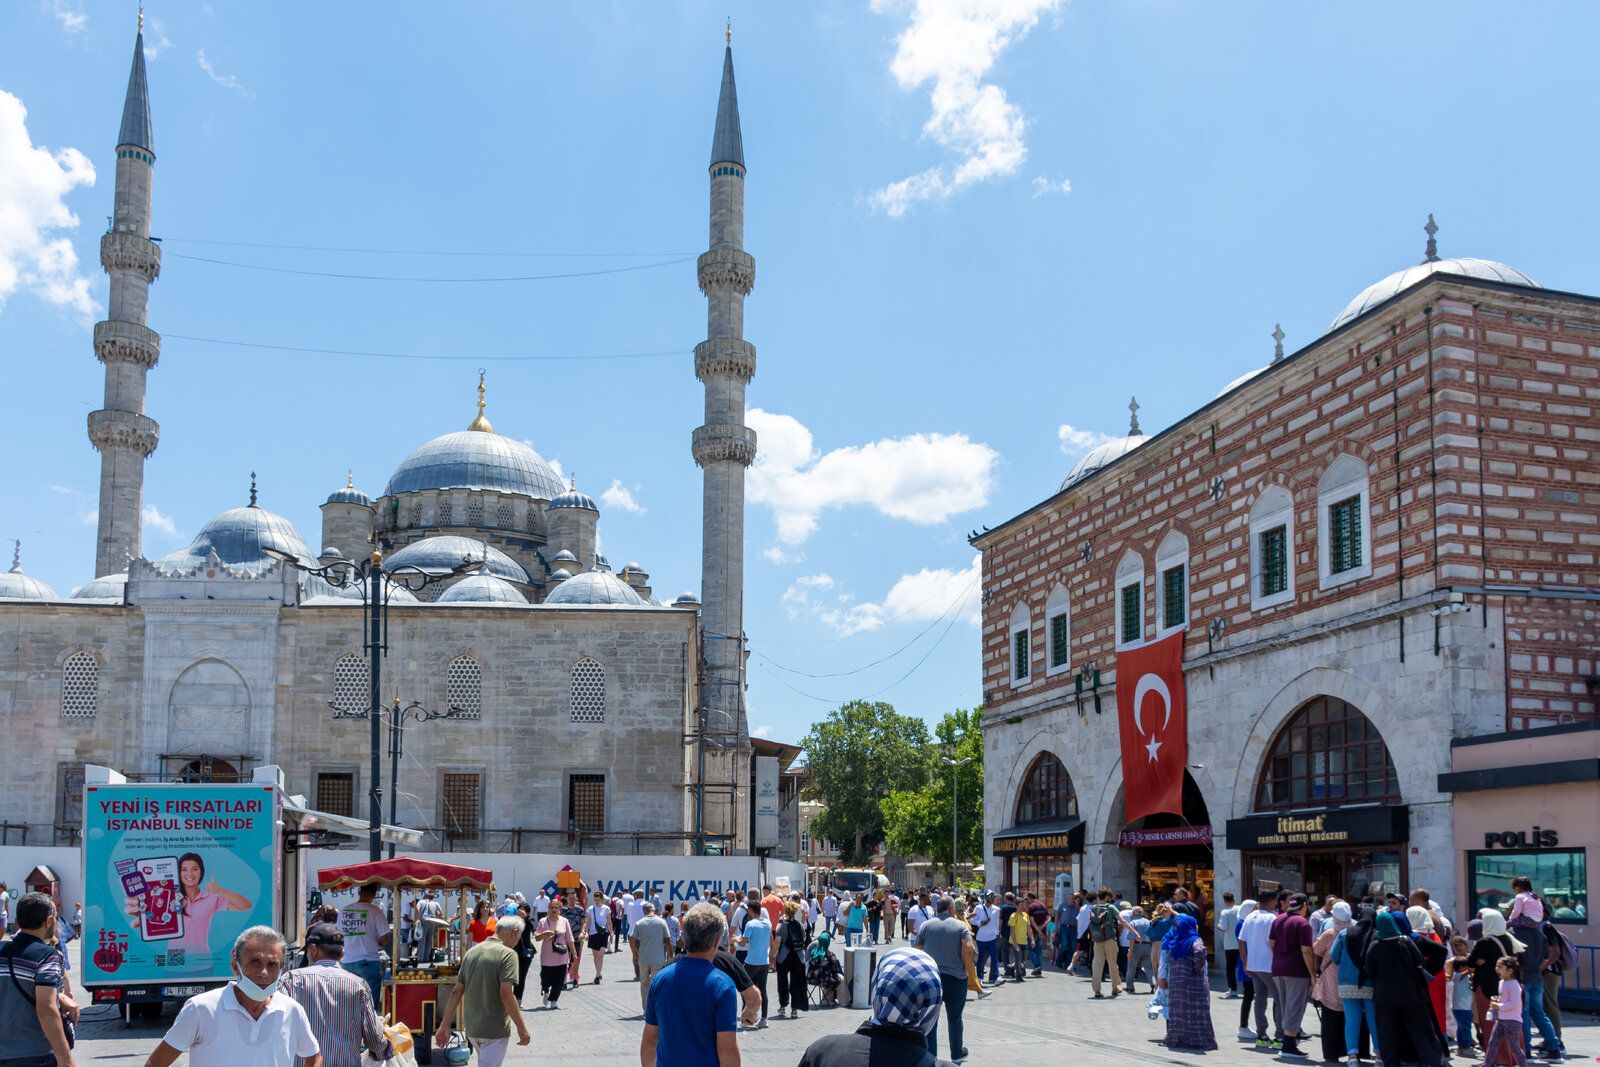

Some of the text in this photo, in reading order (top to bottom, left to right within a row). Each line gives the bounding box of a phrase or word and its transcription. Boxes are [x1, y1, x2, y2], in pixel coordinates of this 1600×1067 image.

[100, 797, 262, 818] YENİ İŞ FIRSATLARI
[107, 815, 254, 831] İSTANBUL SENİN'DE
[1277, 815, 1323, 833] itimat
[1036, 835, 1069, 849] BAZAAR
[1484, 826, 1559, 849] POLİS
[342, 919, 367, 927] NORTH
